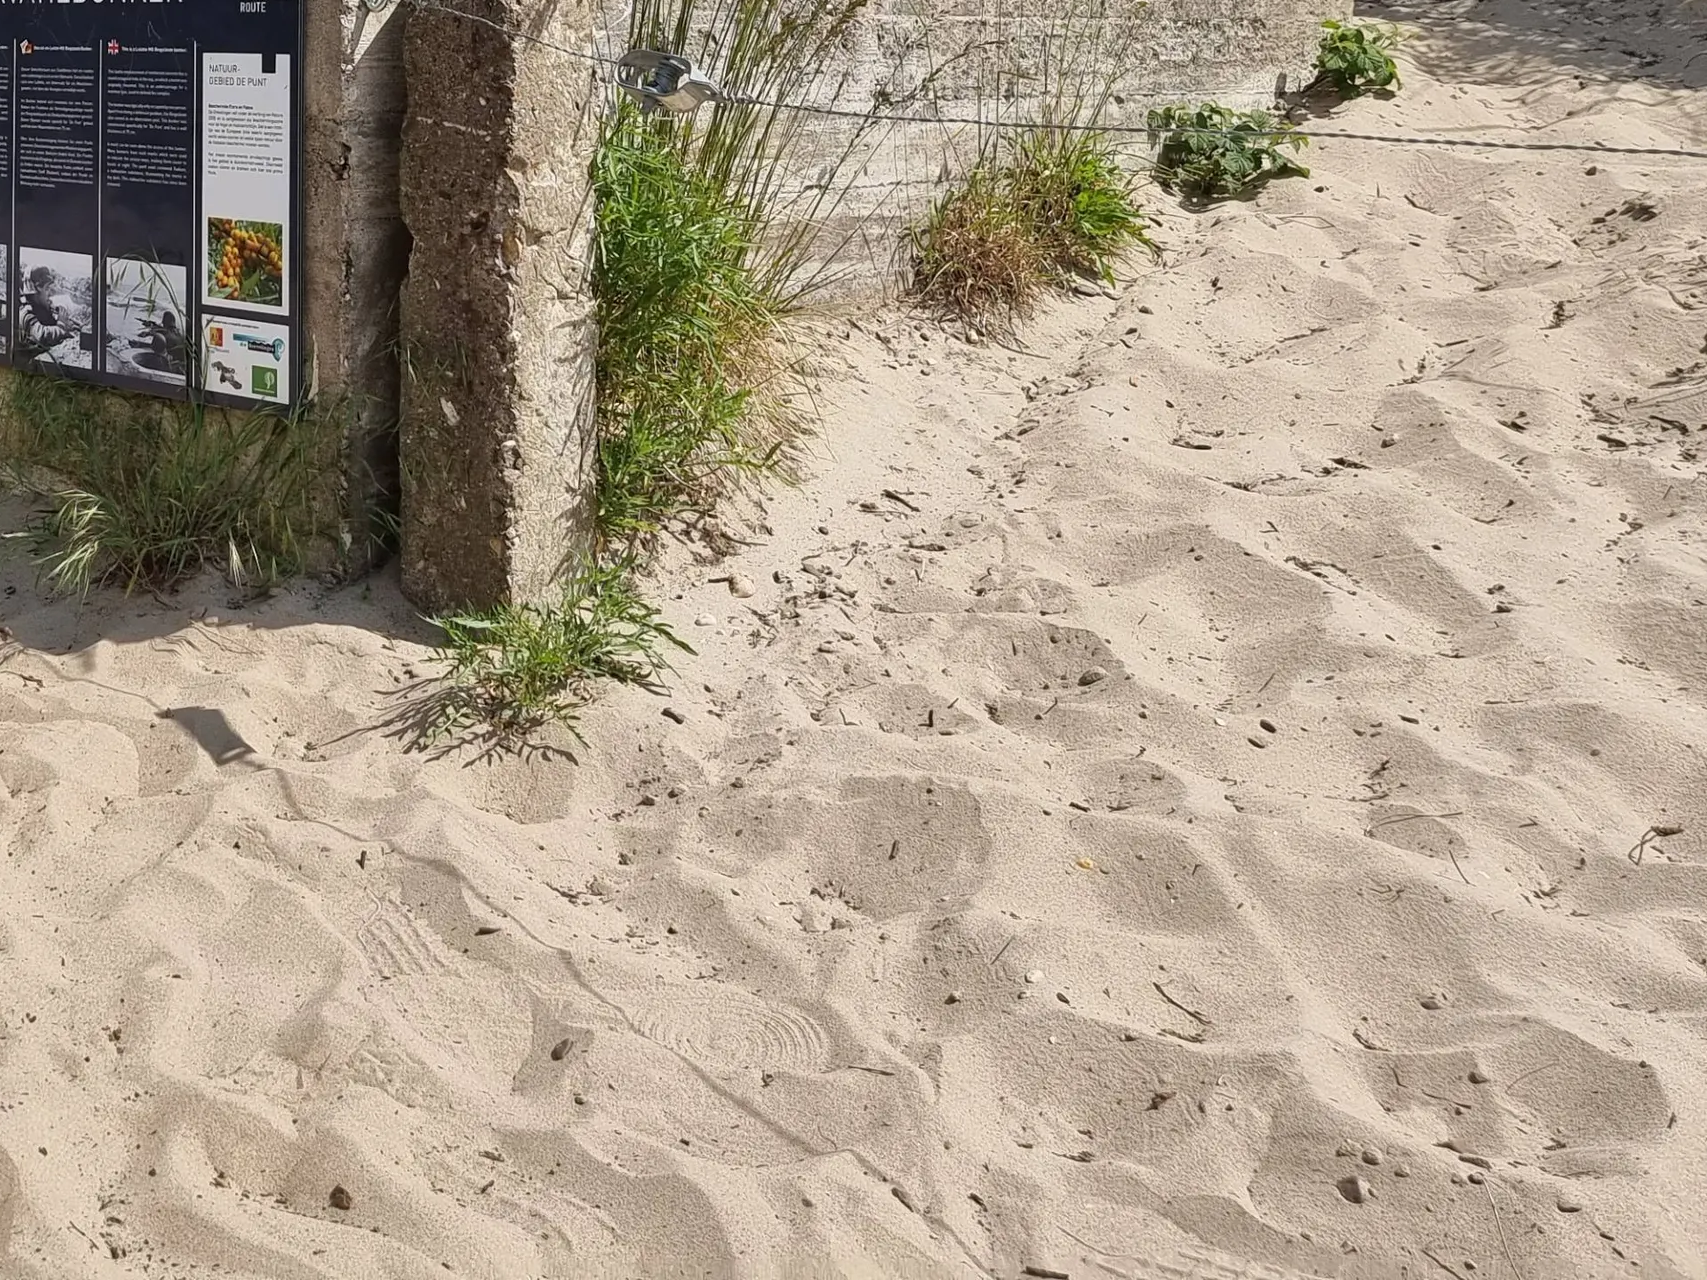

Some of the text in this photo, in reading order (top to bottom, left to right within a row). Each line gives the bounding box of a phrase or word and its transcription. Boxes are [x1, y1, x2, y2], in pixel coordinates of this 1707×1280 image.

[240, 1, 266, 13] ROUTE
[208, 64, 241, 73] NATUUR-
[236, 76, 246, 86] DE
[247, 77, 267, 87] PUNT
